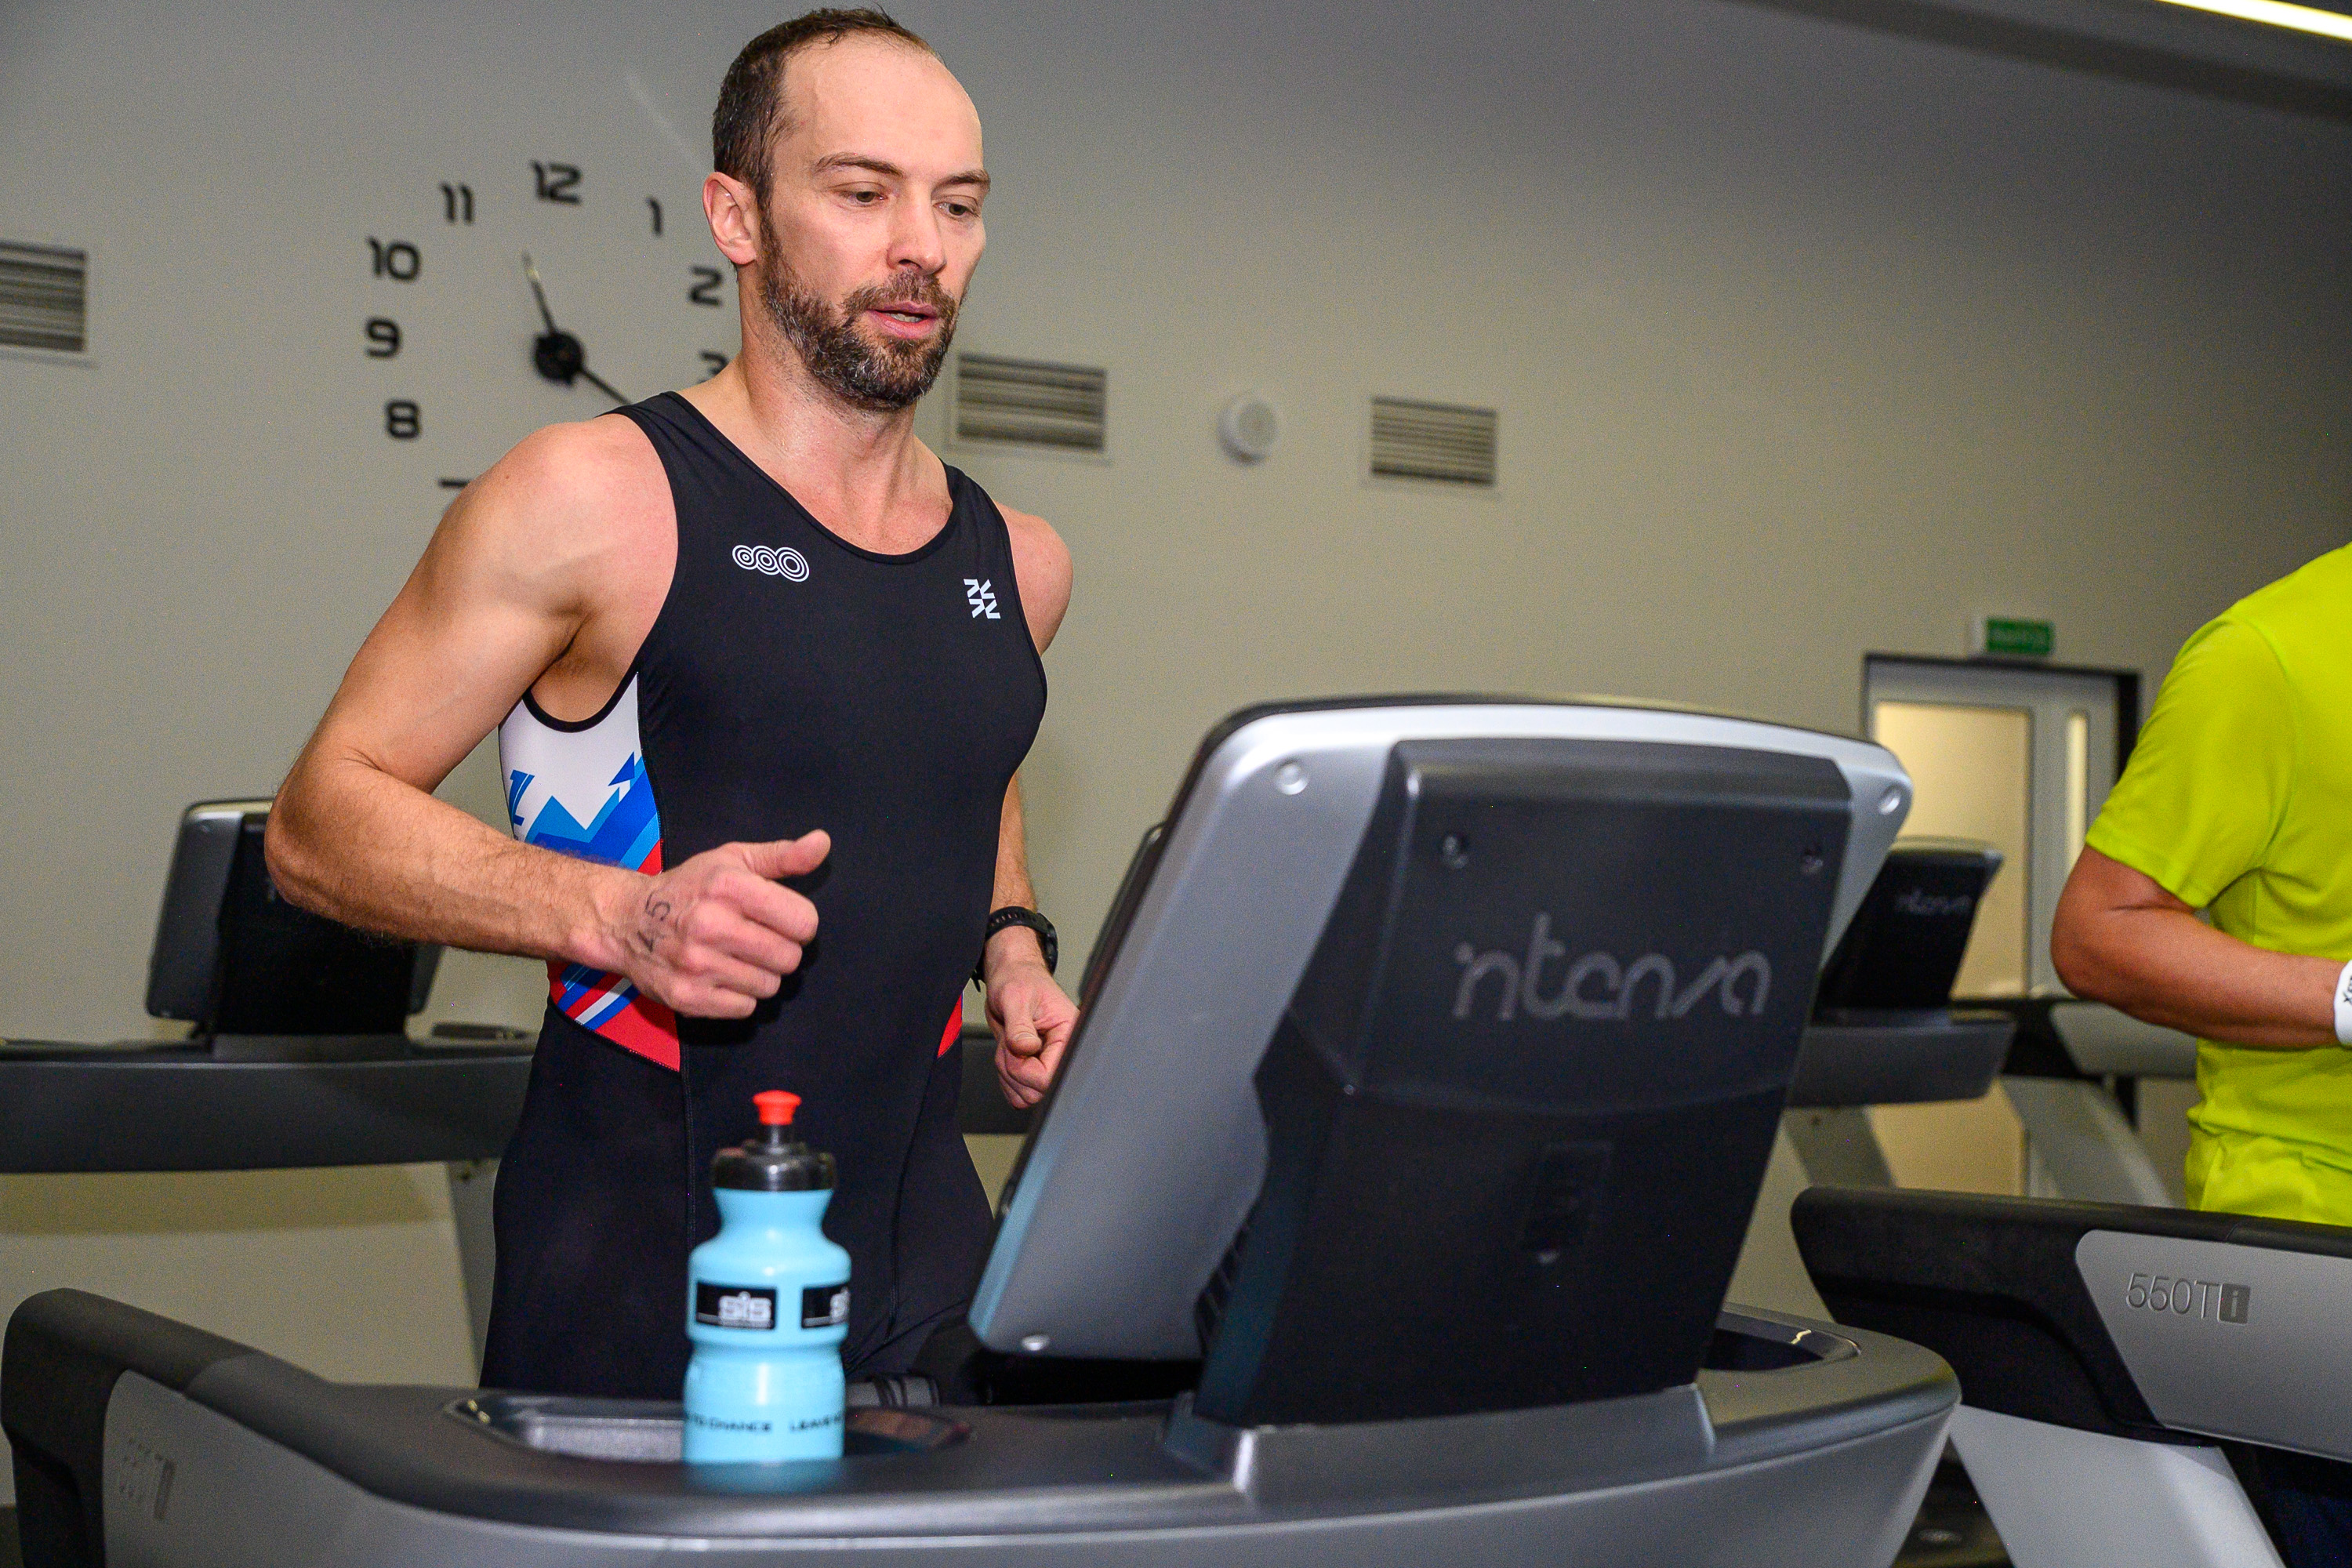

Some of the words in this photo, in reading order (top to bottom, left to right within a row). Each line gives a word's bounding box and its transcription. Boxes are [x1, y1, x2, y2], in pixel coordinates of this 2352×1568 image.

[441, 182, 475, 223] 11
[532, 161, 583, 205] 12
[646, 197, 663, 237] 1
[367, 238, 421, 281] 10
[688, 266, 724, 307] 2
[365, 318, 401, 358] 9
[385, 399, 421, 439] 8
